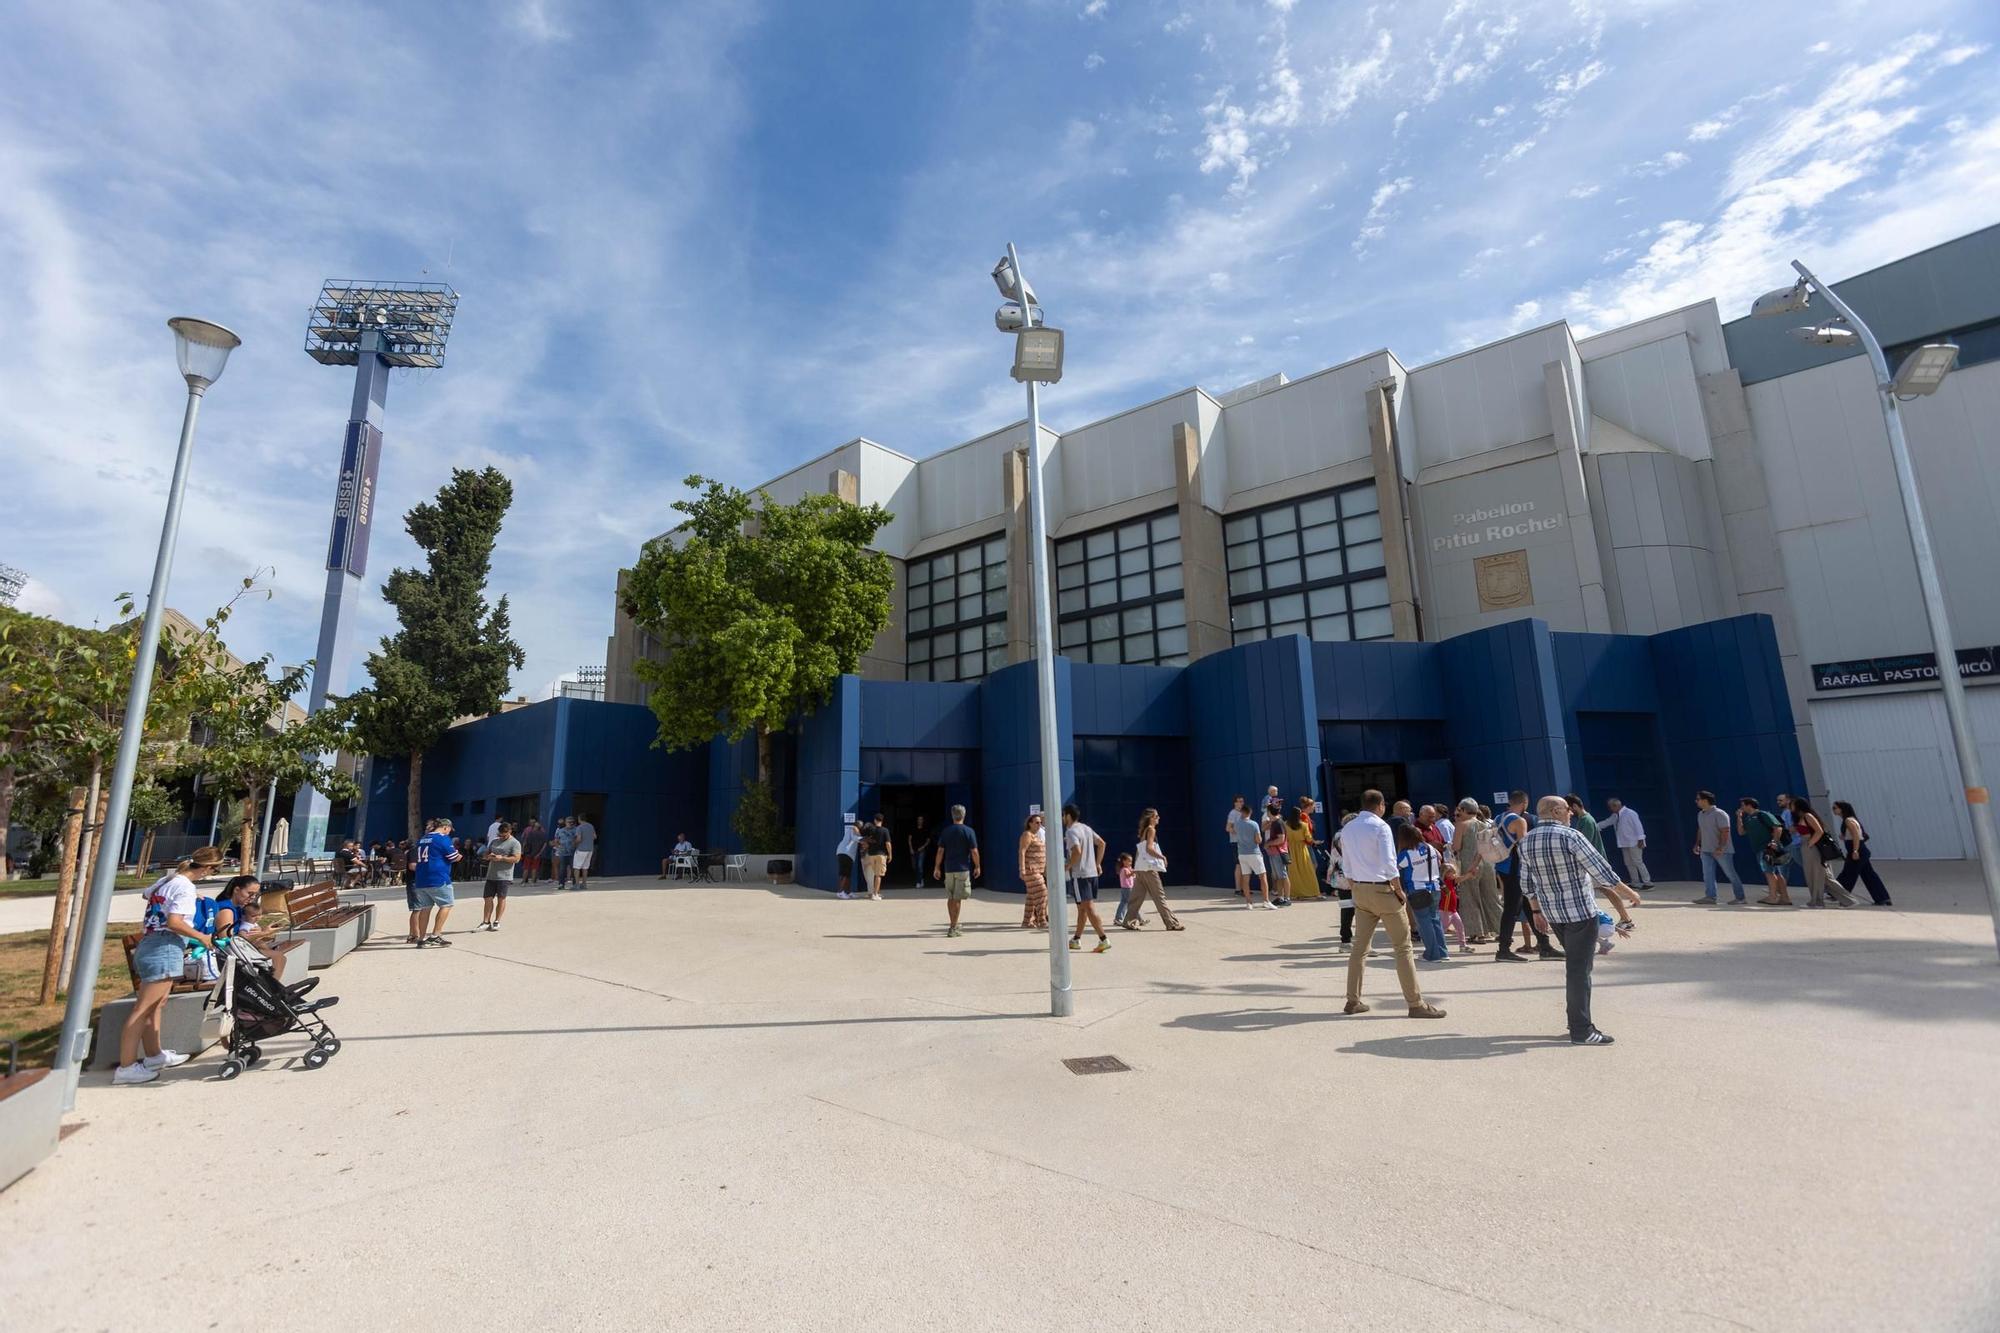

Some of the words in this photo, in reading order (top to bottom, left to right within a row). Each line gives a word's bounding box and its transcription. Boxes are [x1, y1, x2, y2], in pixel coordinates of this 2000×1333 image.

[337, 480, 352, 518] asisa
[359, 487, 371, 525] asisa
[1433, 532, 1480, 551] Pitiu
[1486, 513, 1563, 541] Rochel
[1822, 672, 1879, 686] RAFAEL
[417, 845, 429, 863] 14
